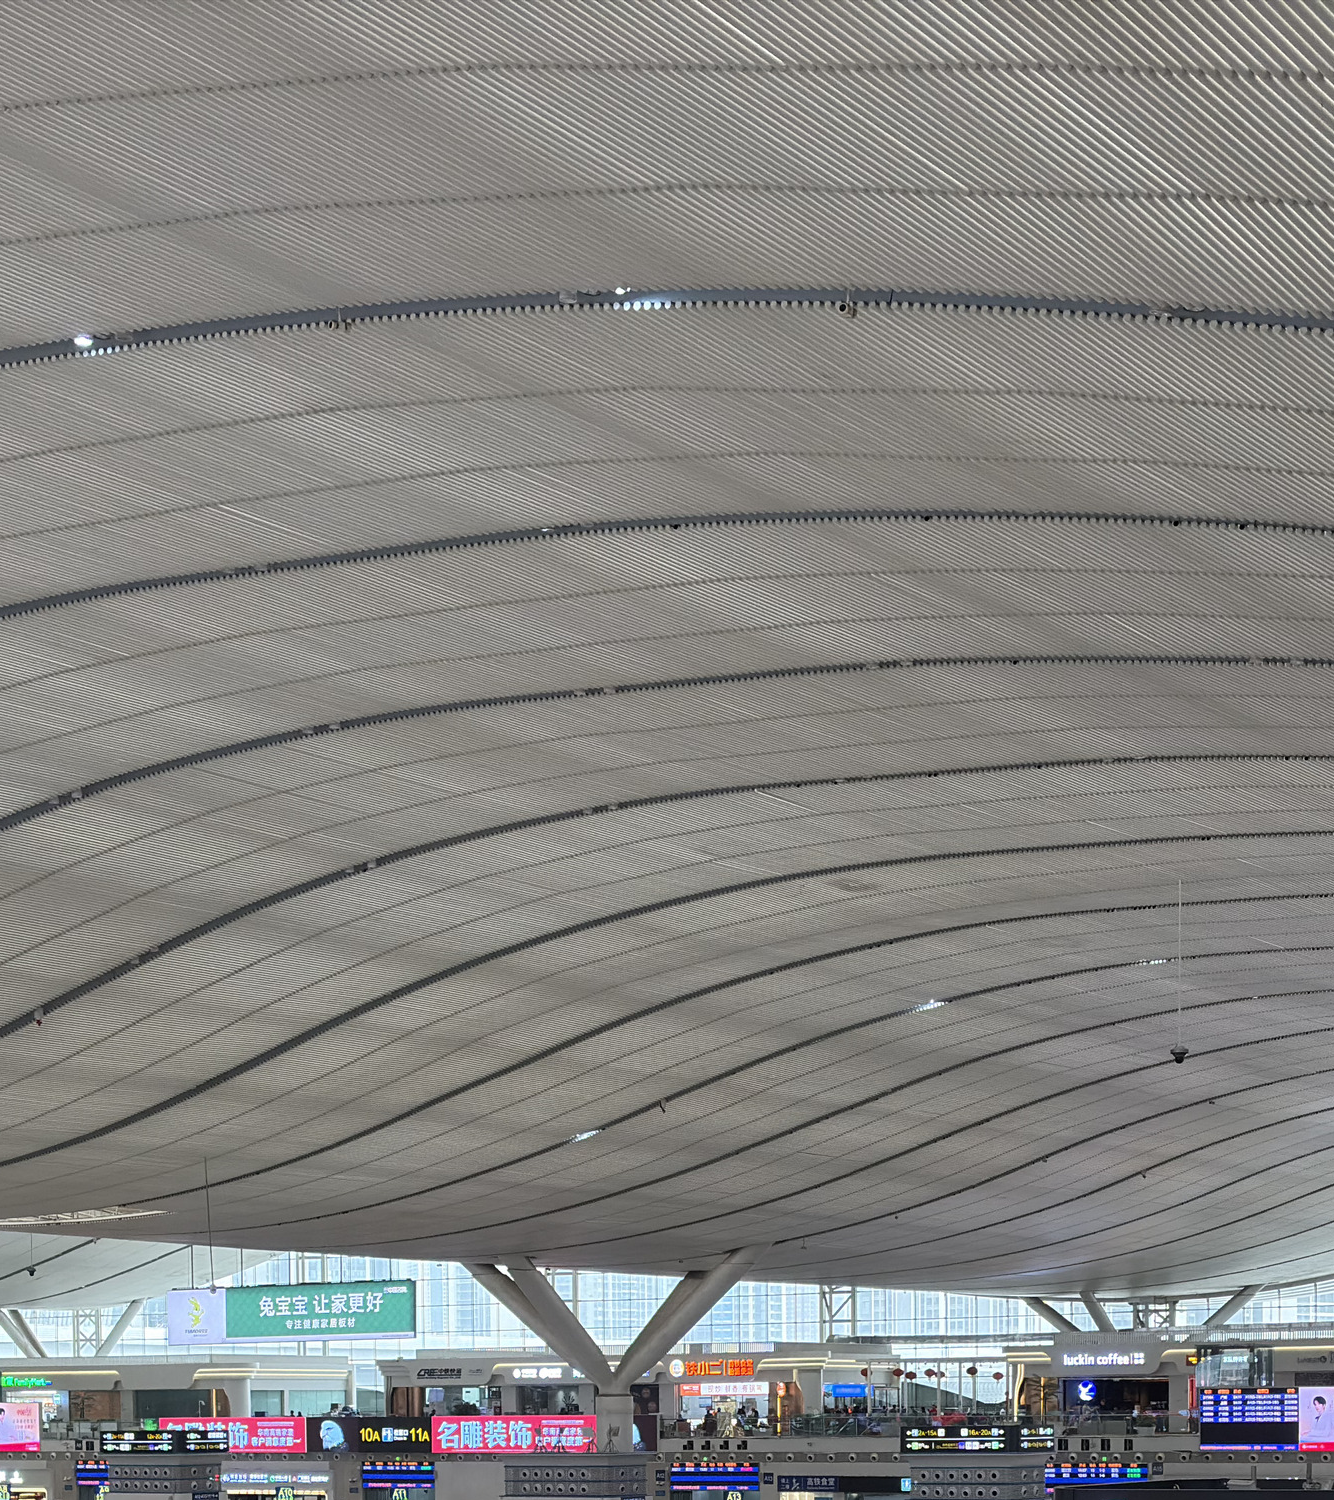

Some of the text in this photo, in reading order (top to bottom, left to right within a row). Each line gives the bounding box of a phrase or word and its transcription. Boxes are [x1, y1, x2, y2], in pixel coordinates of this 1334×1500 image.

[259, 1291, 384, 1317] 兔宝宝 让家更好
[285, 1317, 356, 1330] 专注健康家居板材
[1063, 1353, 1095, 1365] luckin
[1097, 1352, 1130, 1365] coffee
[685, 1358, 723, 1376] 铁小二
[359, 1428, 380, 1442] 10A
[409, 1427, 430, 1442] 11A
[437, 1420, 532, 1450] 名雕装饰
[279, 1488, 293, 1498] A10
[393, 1489, 407, 1499] A11
